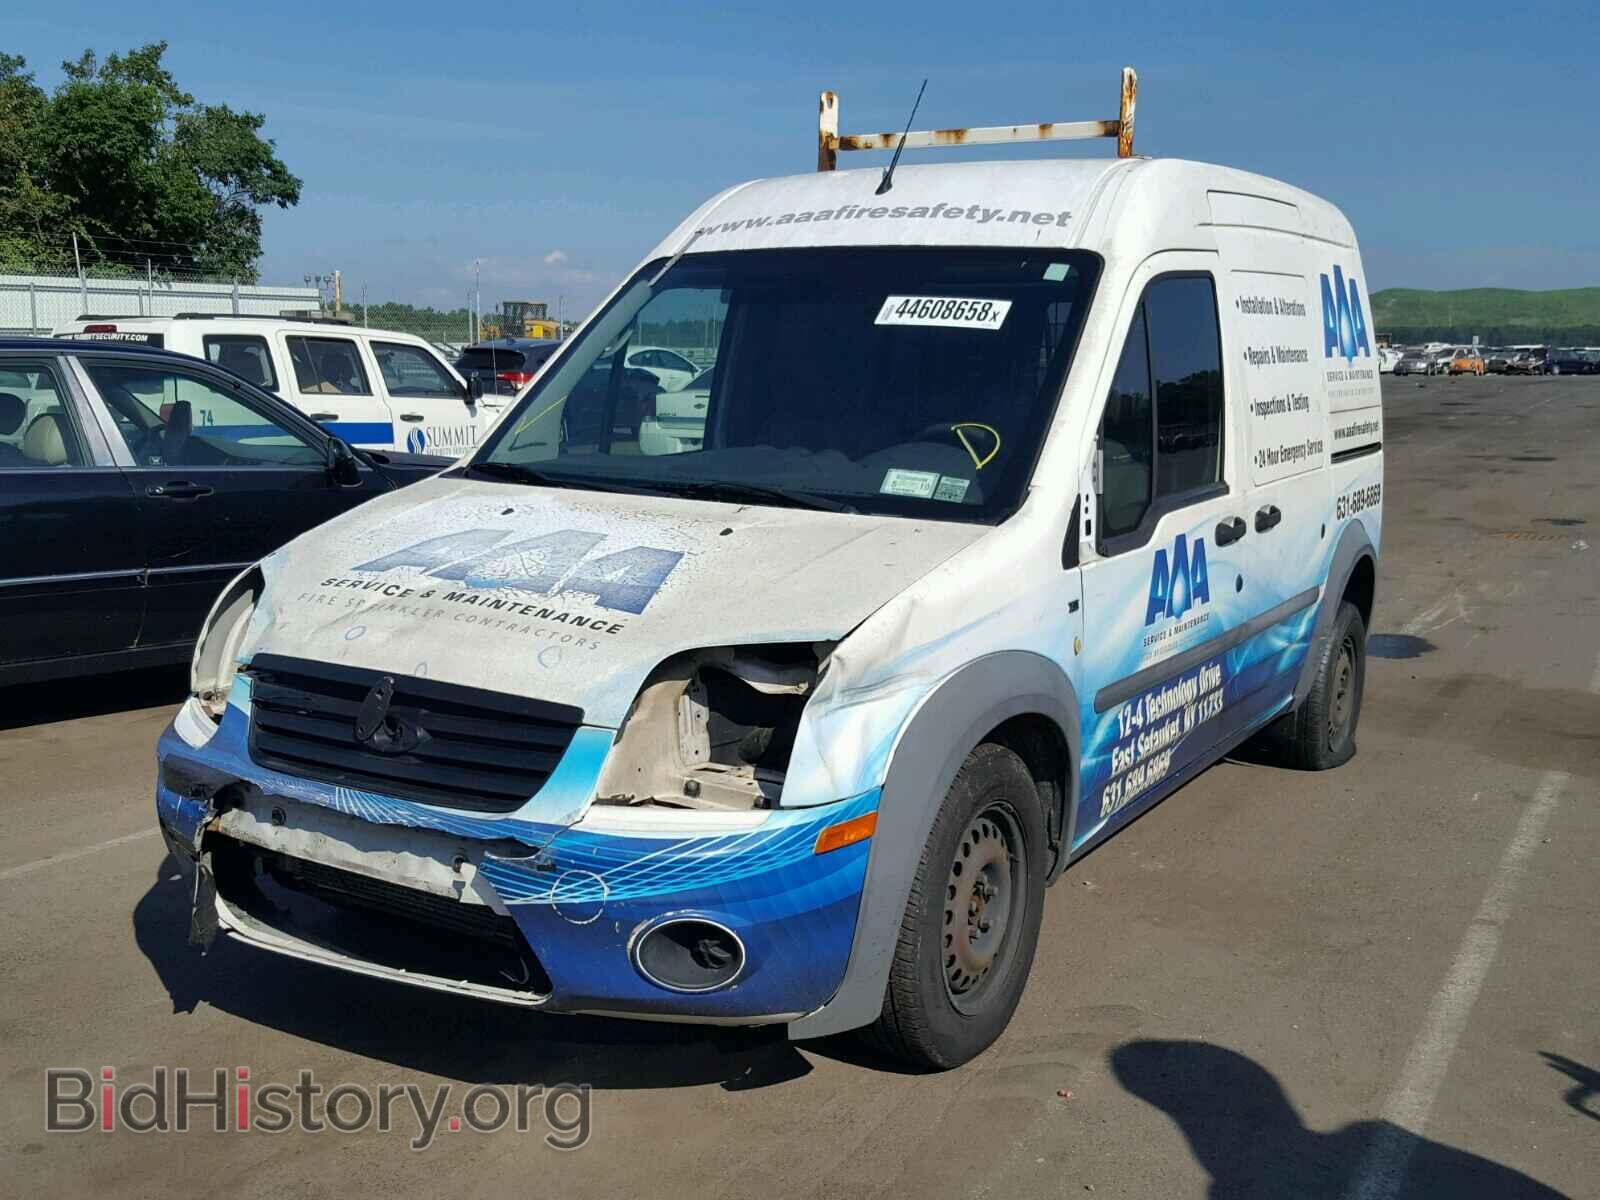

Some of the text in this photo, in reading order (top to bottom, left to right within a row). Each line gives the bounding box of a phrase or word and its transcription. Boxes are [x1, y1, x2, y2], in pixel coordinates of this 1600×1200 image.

[698, 203, 1073, 237] www.aaafiresafety.net
[1239, 295, 1274, 315] Installation
[1279, 296, 1306, 317] Alterations
[1320, 264, 1371, 367] AAA
[1247, 346, 1271, 368] Repairs
[1275, 345, 1308, 364] Maintenance
[1254, 396, 1286, 420] Inspections
[1291, 393, 1310, 413] Testing
[426, 425, 477, 448] SUMMIT
[1258, 438, 1323, 468] 24 Hour Emergency Service
[1336, 482, 1381, 521] 631-689-6869
[349, 528, 685, 616] AAA
[1144, 533, 1210, 627] AAA
[297, 592, 338, 606] FIRE
[453, 612, 601, 650] CONTRACTORS
[321, 577, 625, 635] SERVICE & MAINTENANCE
[1143, 631, 1168, 648] SERVICE
[1118, 661, 1222, 740] 12-4 Technology Drive
[1110, 737, 1136, 779] East
[1183, 700, 1199, 734] NY
[1198, 687, 1224, 726] 11733
